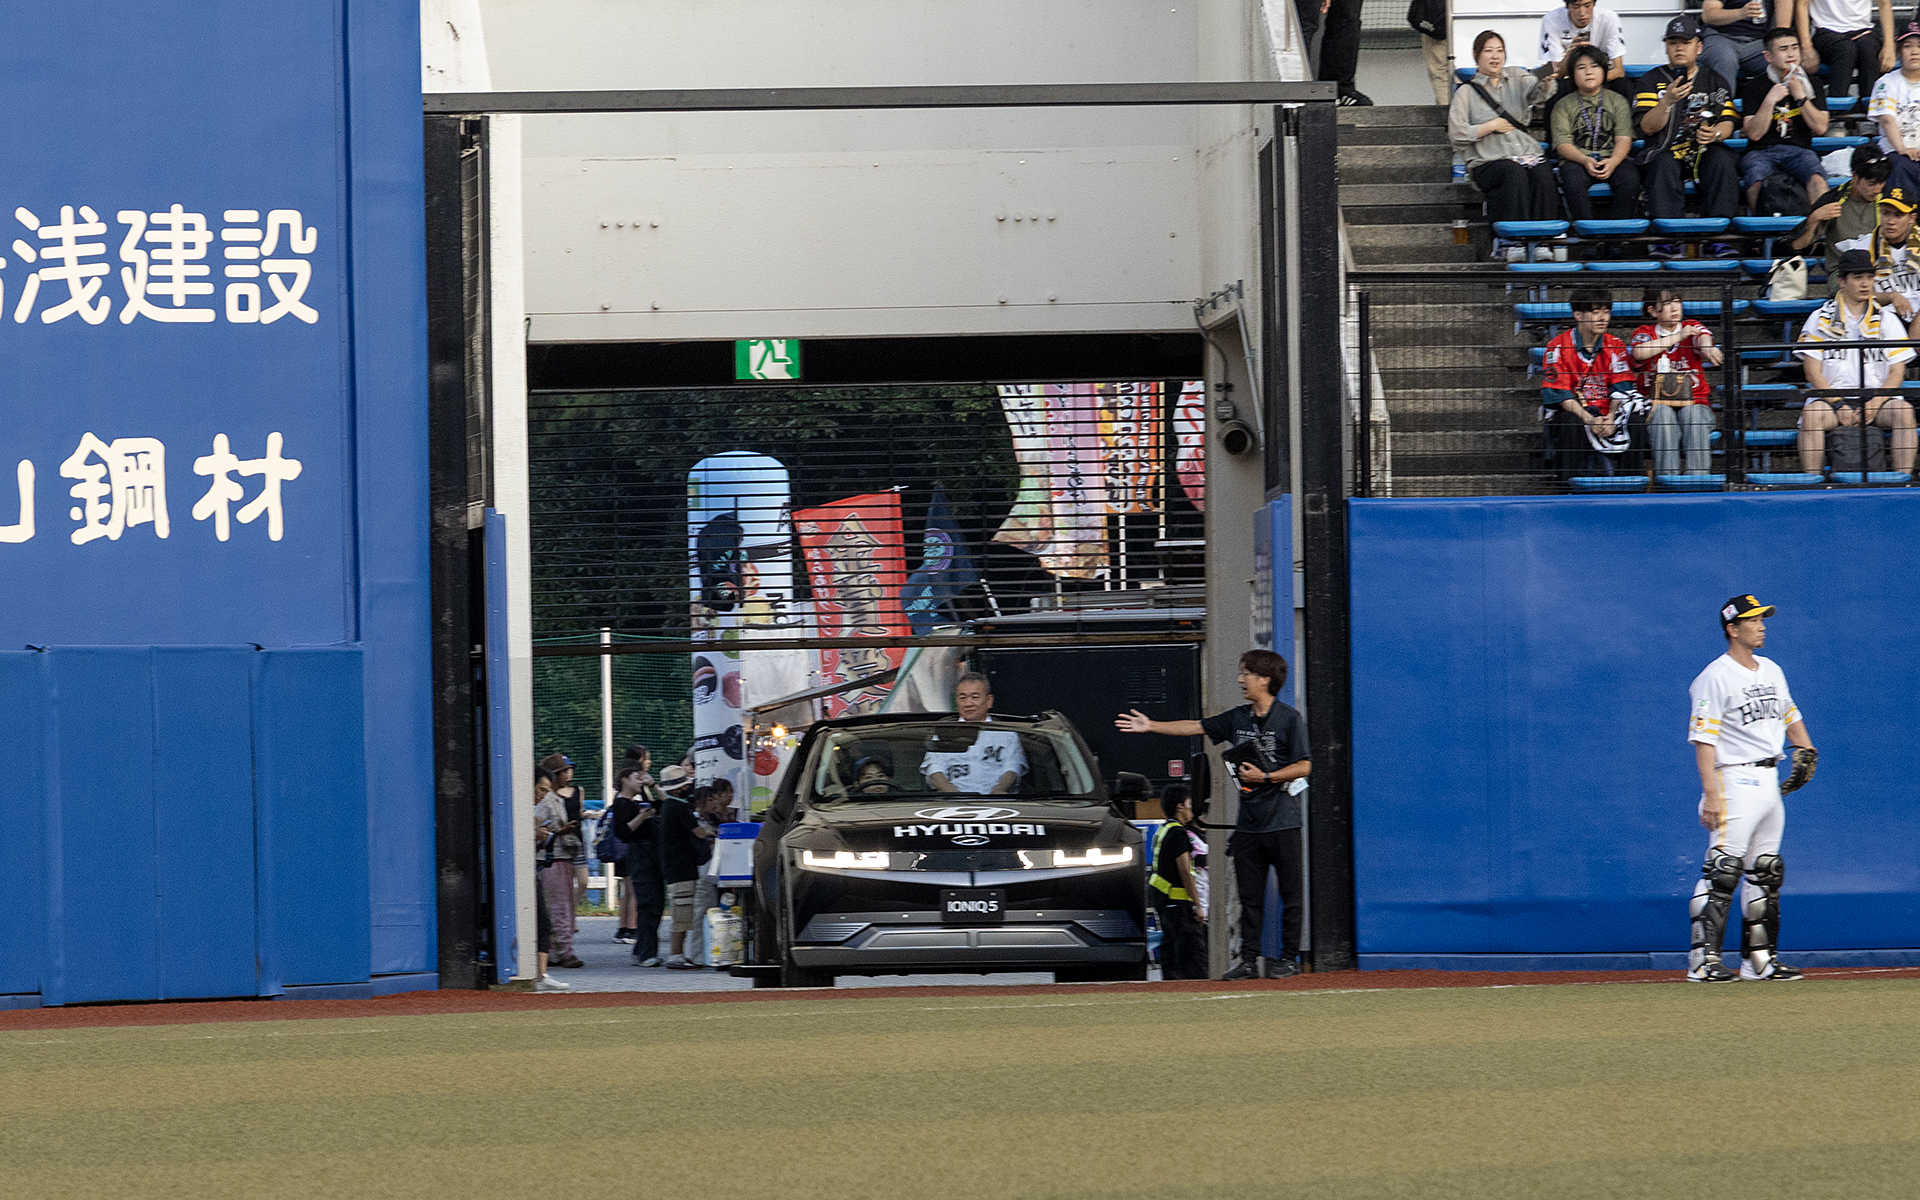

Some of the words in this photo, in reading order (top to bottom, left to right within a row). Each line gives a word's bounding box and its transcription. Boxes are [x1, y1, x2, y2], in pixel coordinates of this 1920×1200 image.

[0, 203, 319, 325] 浅建設
[893, 823, 1047, 838] HYUNDAI
